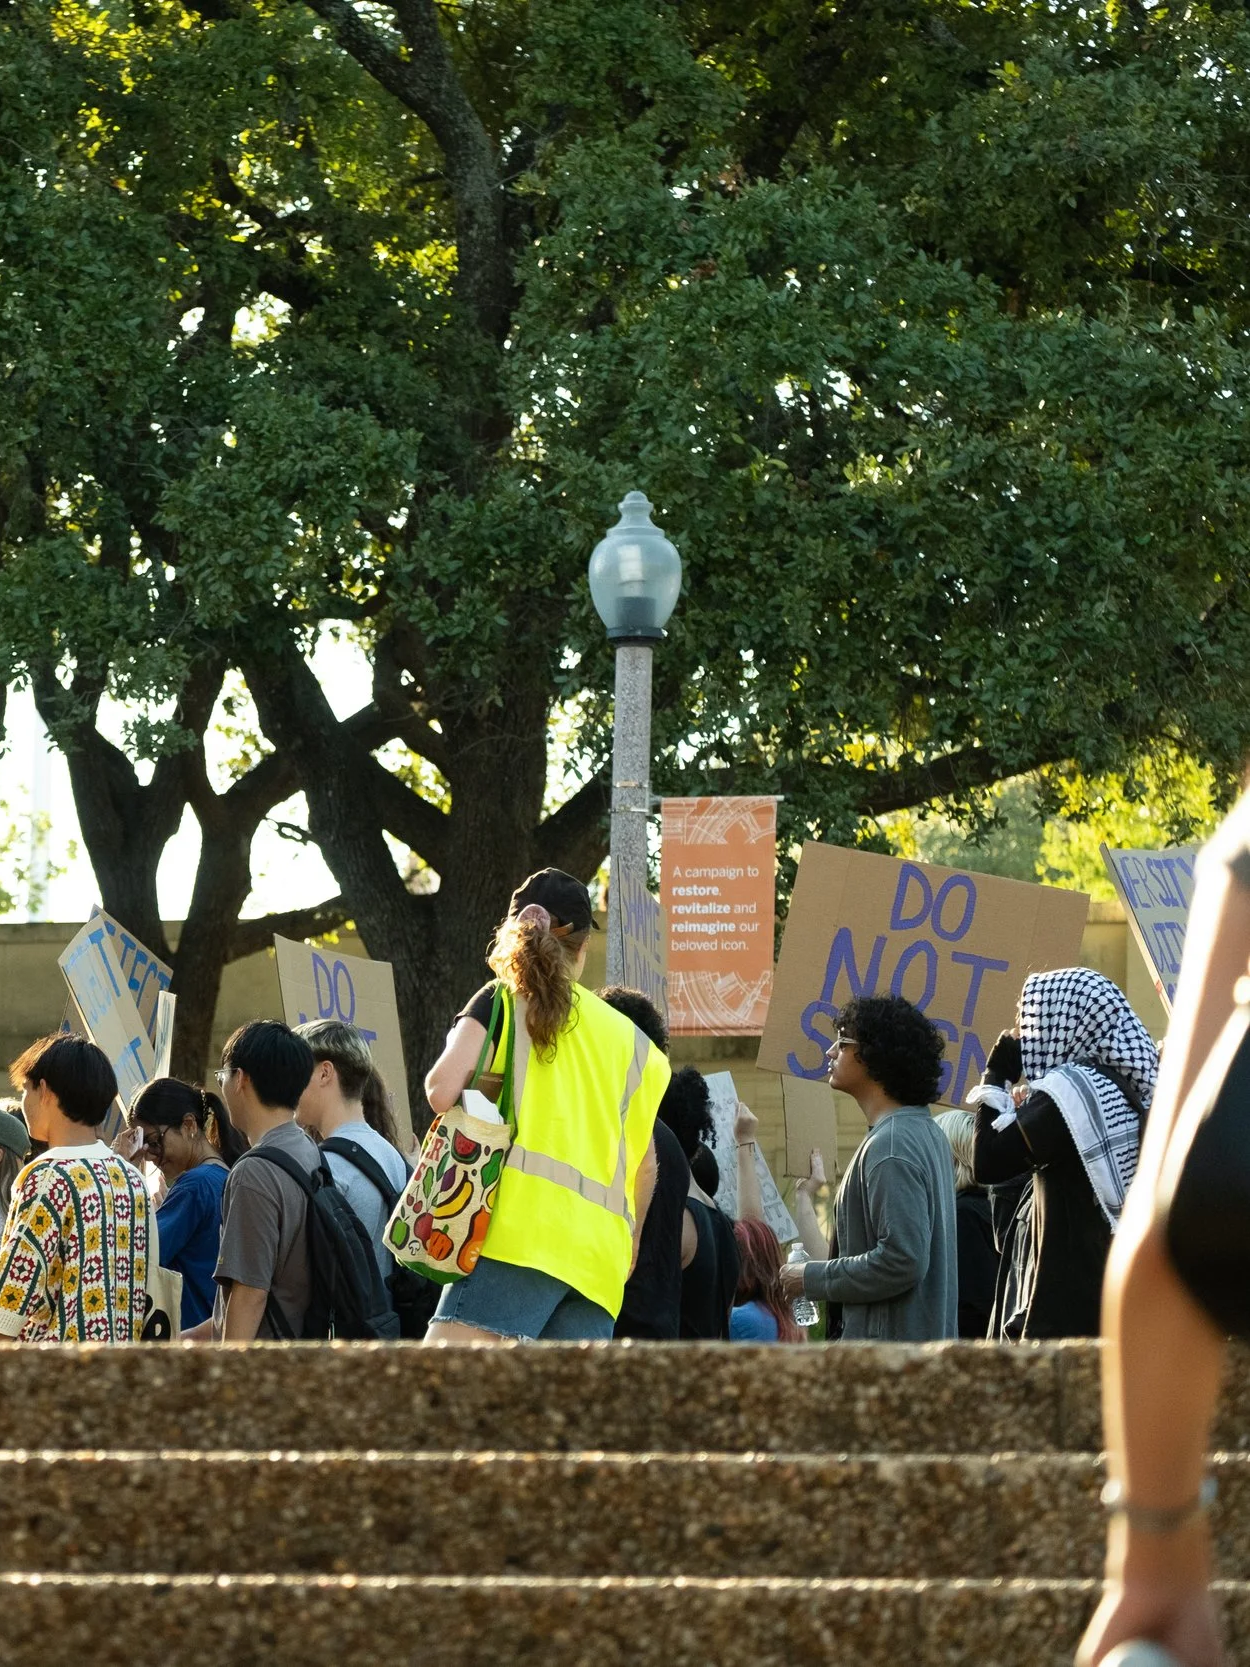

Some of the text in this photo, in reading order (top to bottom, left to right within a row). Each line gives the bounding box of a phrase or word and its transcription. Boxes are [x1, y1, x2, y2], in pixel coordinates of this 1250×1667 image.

[672, 865, 759, 880] A campaign to
[672, 901, 757, 914] revitalize and
[890, 862, 977, 942] DO
[671, 921, 760, 935] reimagine our
[671, 939, 750, 952] beloved icon.
[819, 926, 1010, 1028] NOT
[312, 952, 355, 1024] DO
